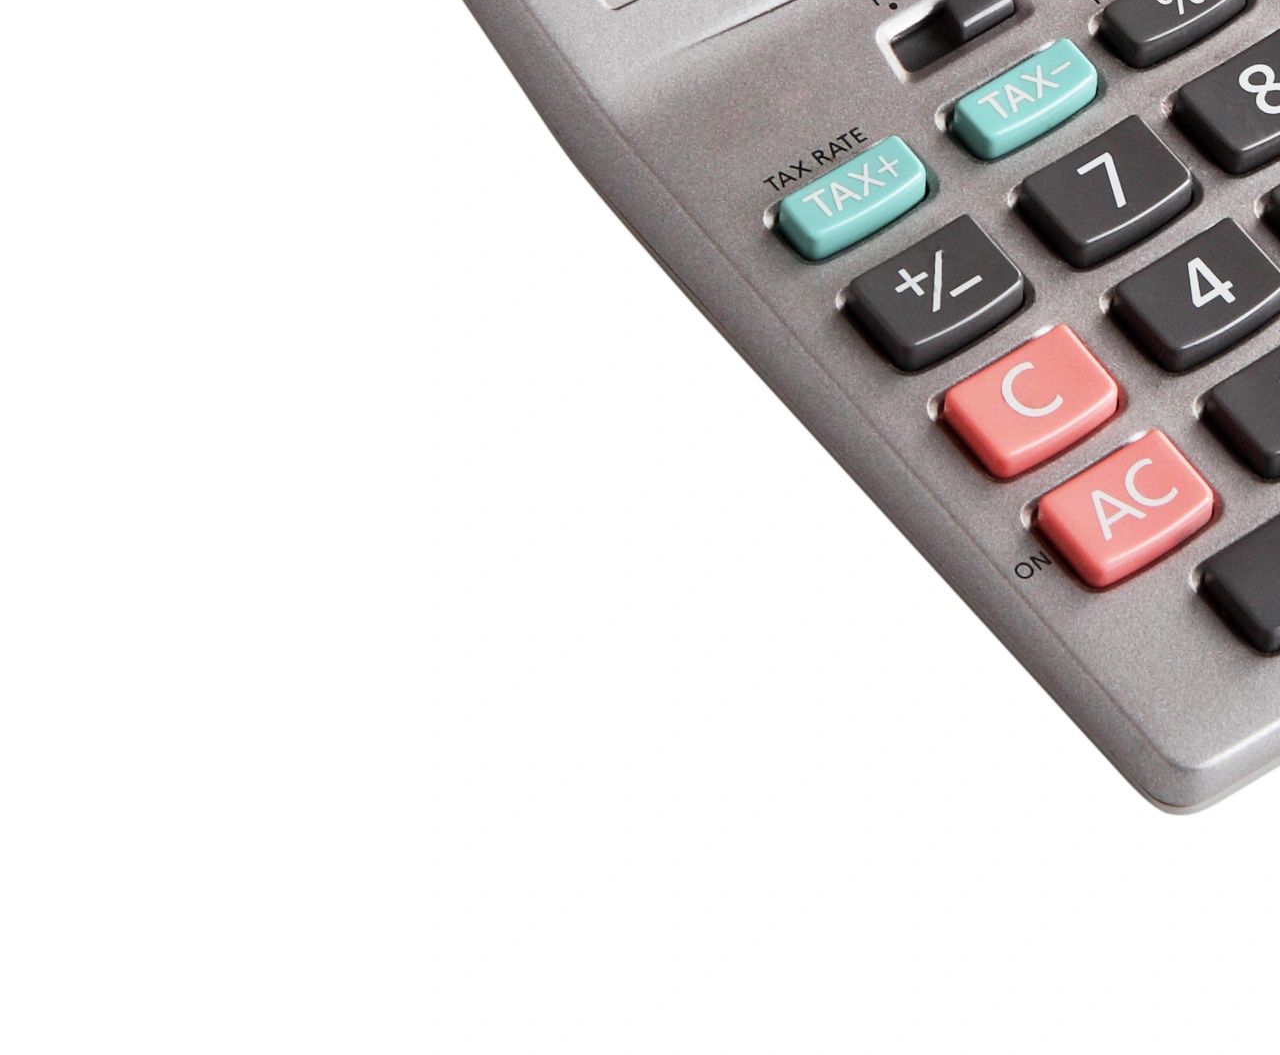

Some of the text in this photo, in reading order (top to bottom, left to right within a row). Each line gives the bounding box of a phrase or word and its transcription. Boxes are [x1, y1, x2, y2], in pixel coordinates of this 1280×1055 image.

[764, 127, 868, 193] TAX RATE
[803, 156, 899, 217] TAX+
[1077, 152, 1126, 208] 7
[1186, 257, 1236, 309] 4
[1001, 361, 1063, 417] C
[1091, 458, 1178, 541] AC
[1014, 551, 1052, 580] ON
